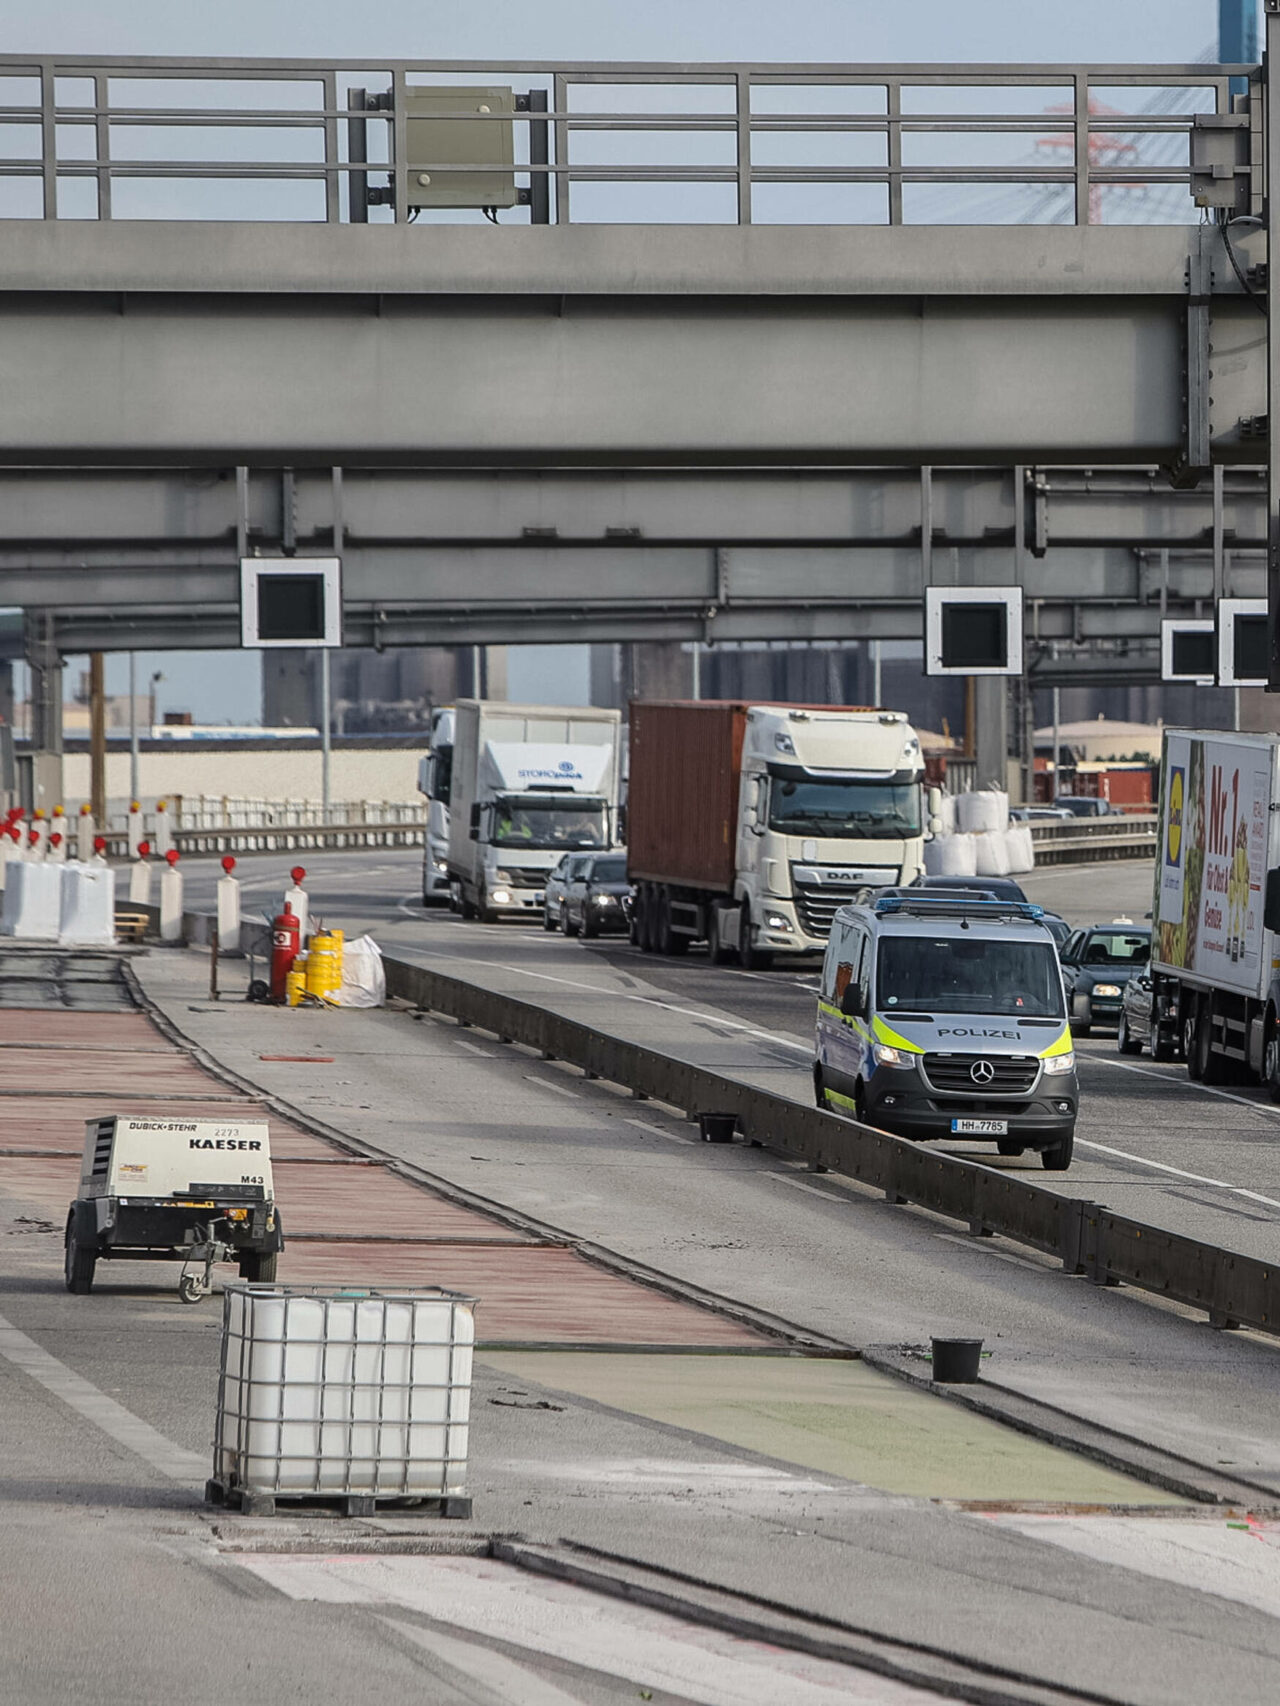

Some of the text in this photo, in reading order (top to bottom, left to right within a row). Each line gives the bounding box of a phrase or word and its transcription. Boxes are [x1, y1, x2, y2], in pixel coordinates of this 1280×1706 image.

[938, 1028, 1021, 1040] POLIZEI
[962, 1121, 1003, 1131] HH 7785
[214, 1128, 240, 1137] 2273
[189, 1139, 262, 1151] KAESER
[241, 1175, 264, 1184] M43
